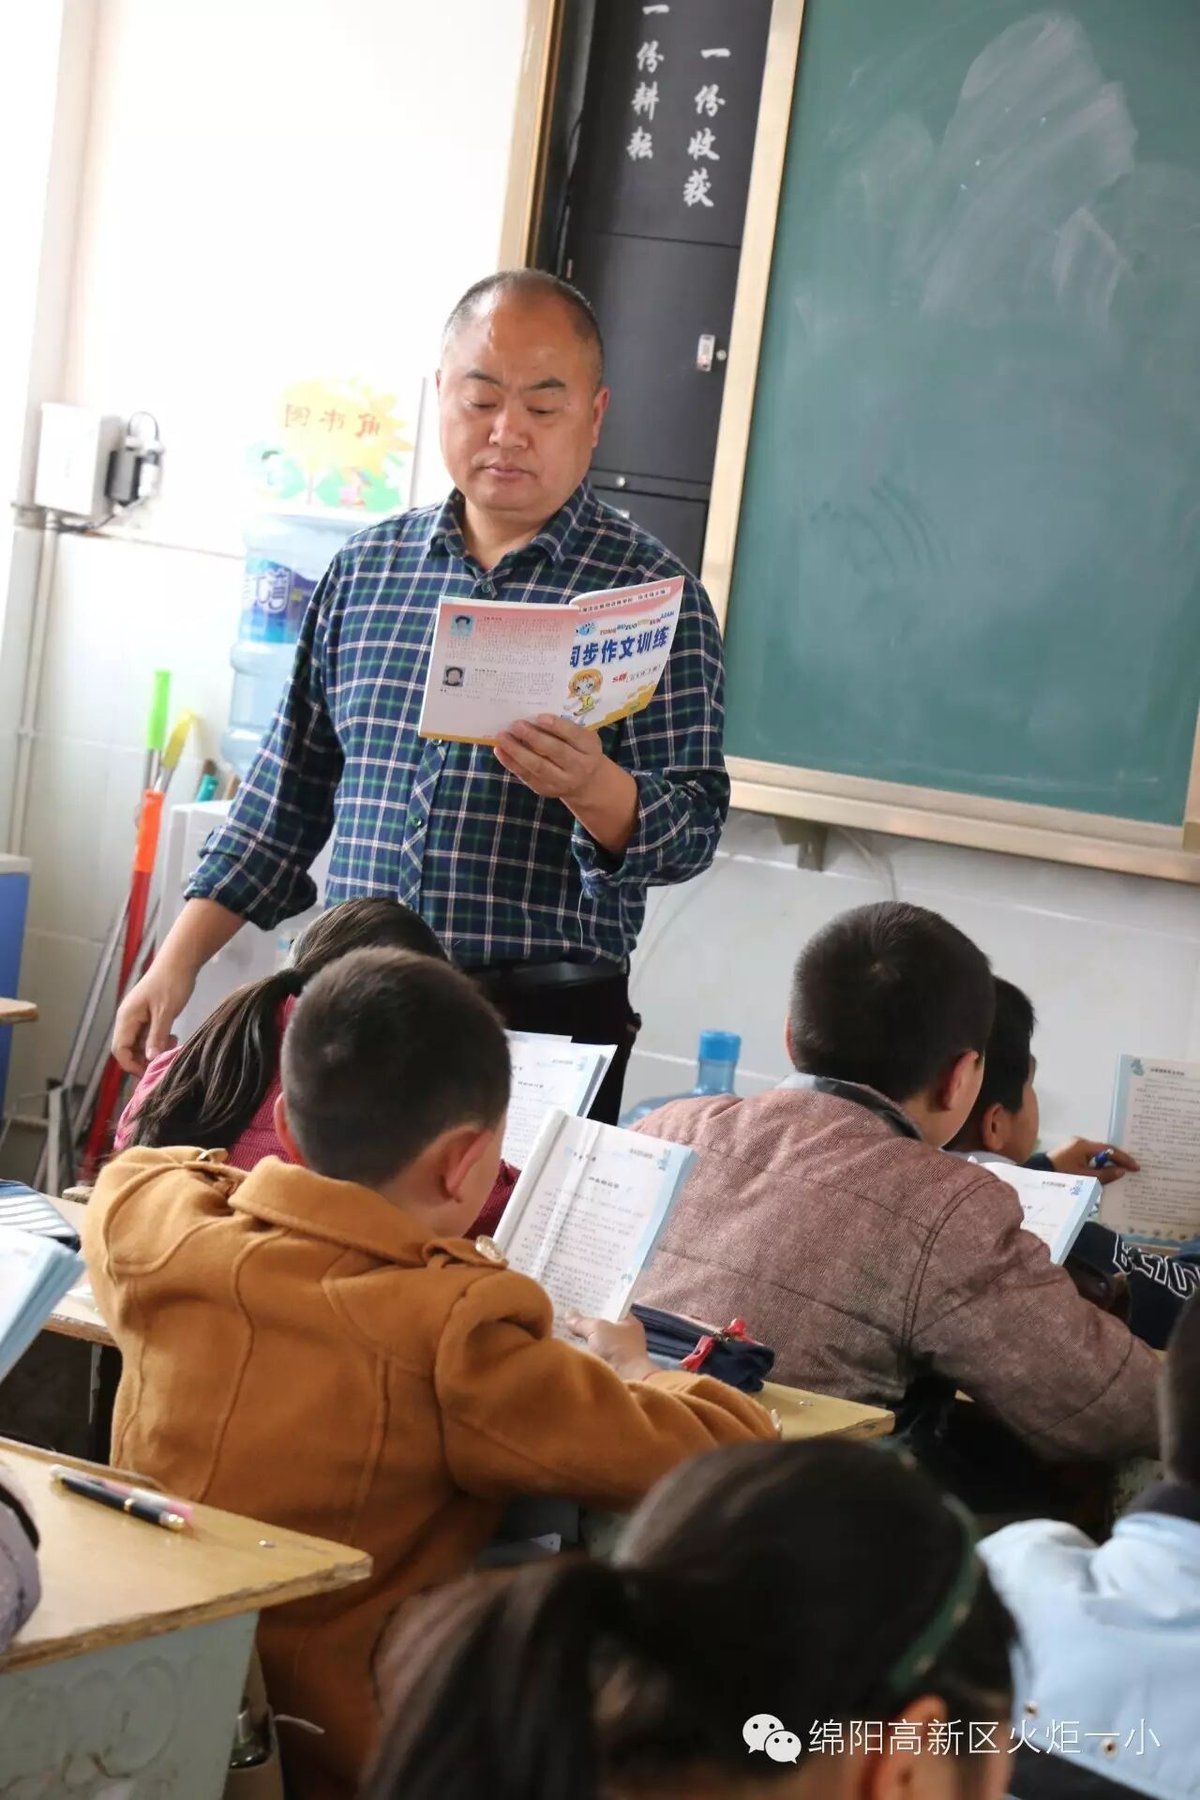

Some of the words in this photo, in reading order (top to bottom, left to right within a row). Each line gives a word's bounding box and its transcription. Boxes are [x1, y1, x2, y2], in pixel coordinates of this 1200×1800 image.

[627, 4, 670, 162] 一份耕耘
[683, 48, 732, 208] 一份收获
[284, 403, 381, 438] 图书角
